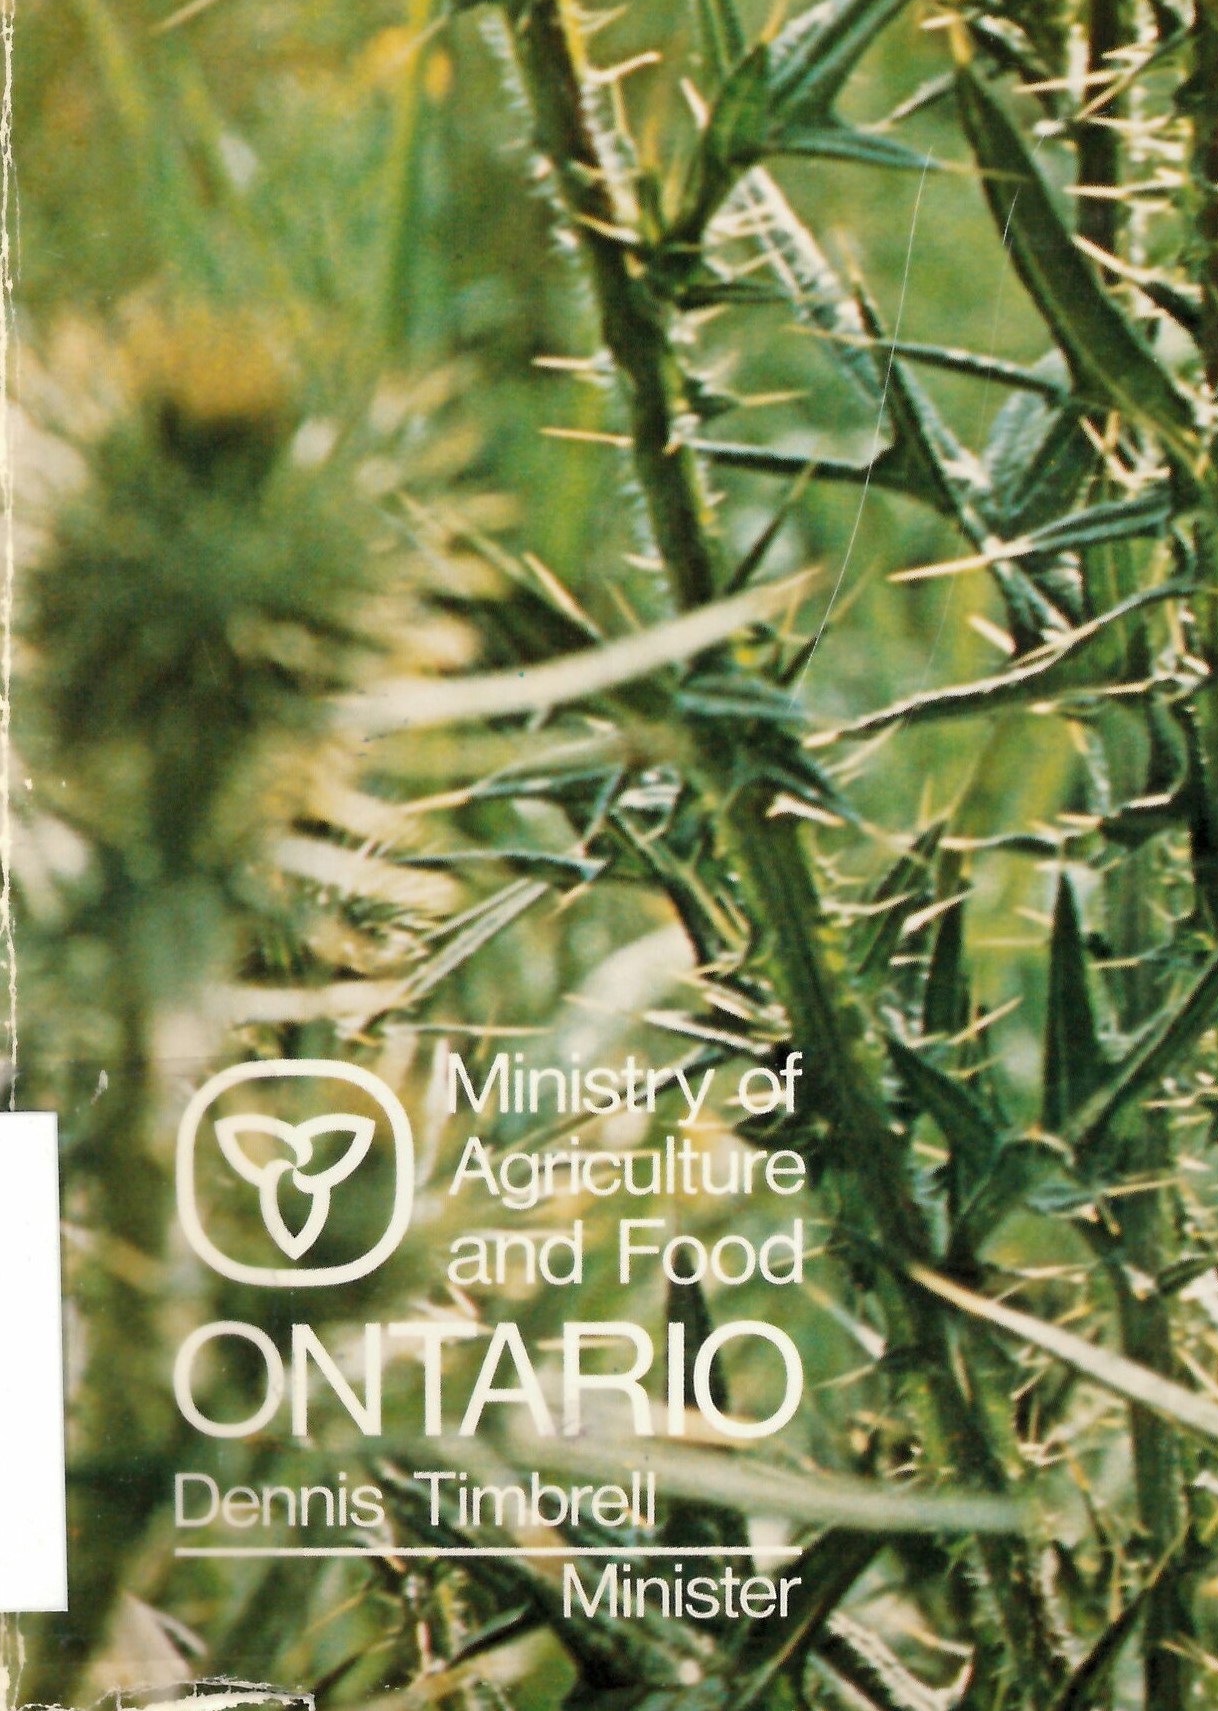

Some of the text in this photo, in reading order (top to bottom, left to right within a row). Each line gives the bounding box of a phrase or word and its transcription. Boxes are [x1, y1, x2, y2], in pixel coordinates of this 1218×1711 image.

[448, 1052, 803, 1125] Ministry of
[449, 1136, 805, 1210] Agriculture
[448, 1218, 803, 1285] and Food
[174, 1320, 803, 1438] ONTARIO
[175, 1470, 655, 1528] Dennis Timbrell
[563, 1563, 801, 1619] Minister
